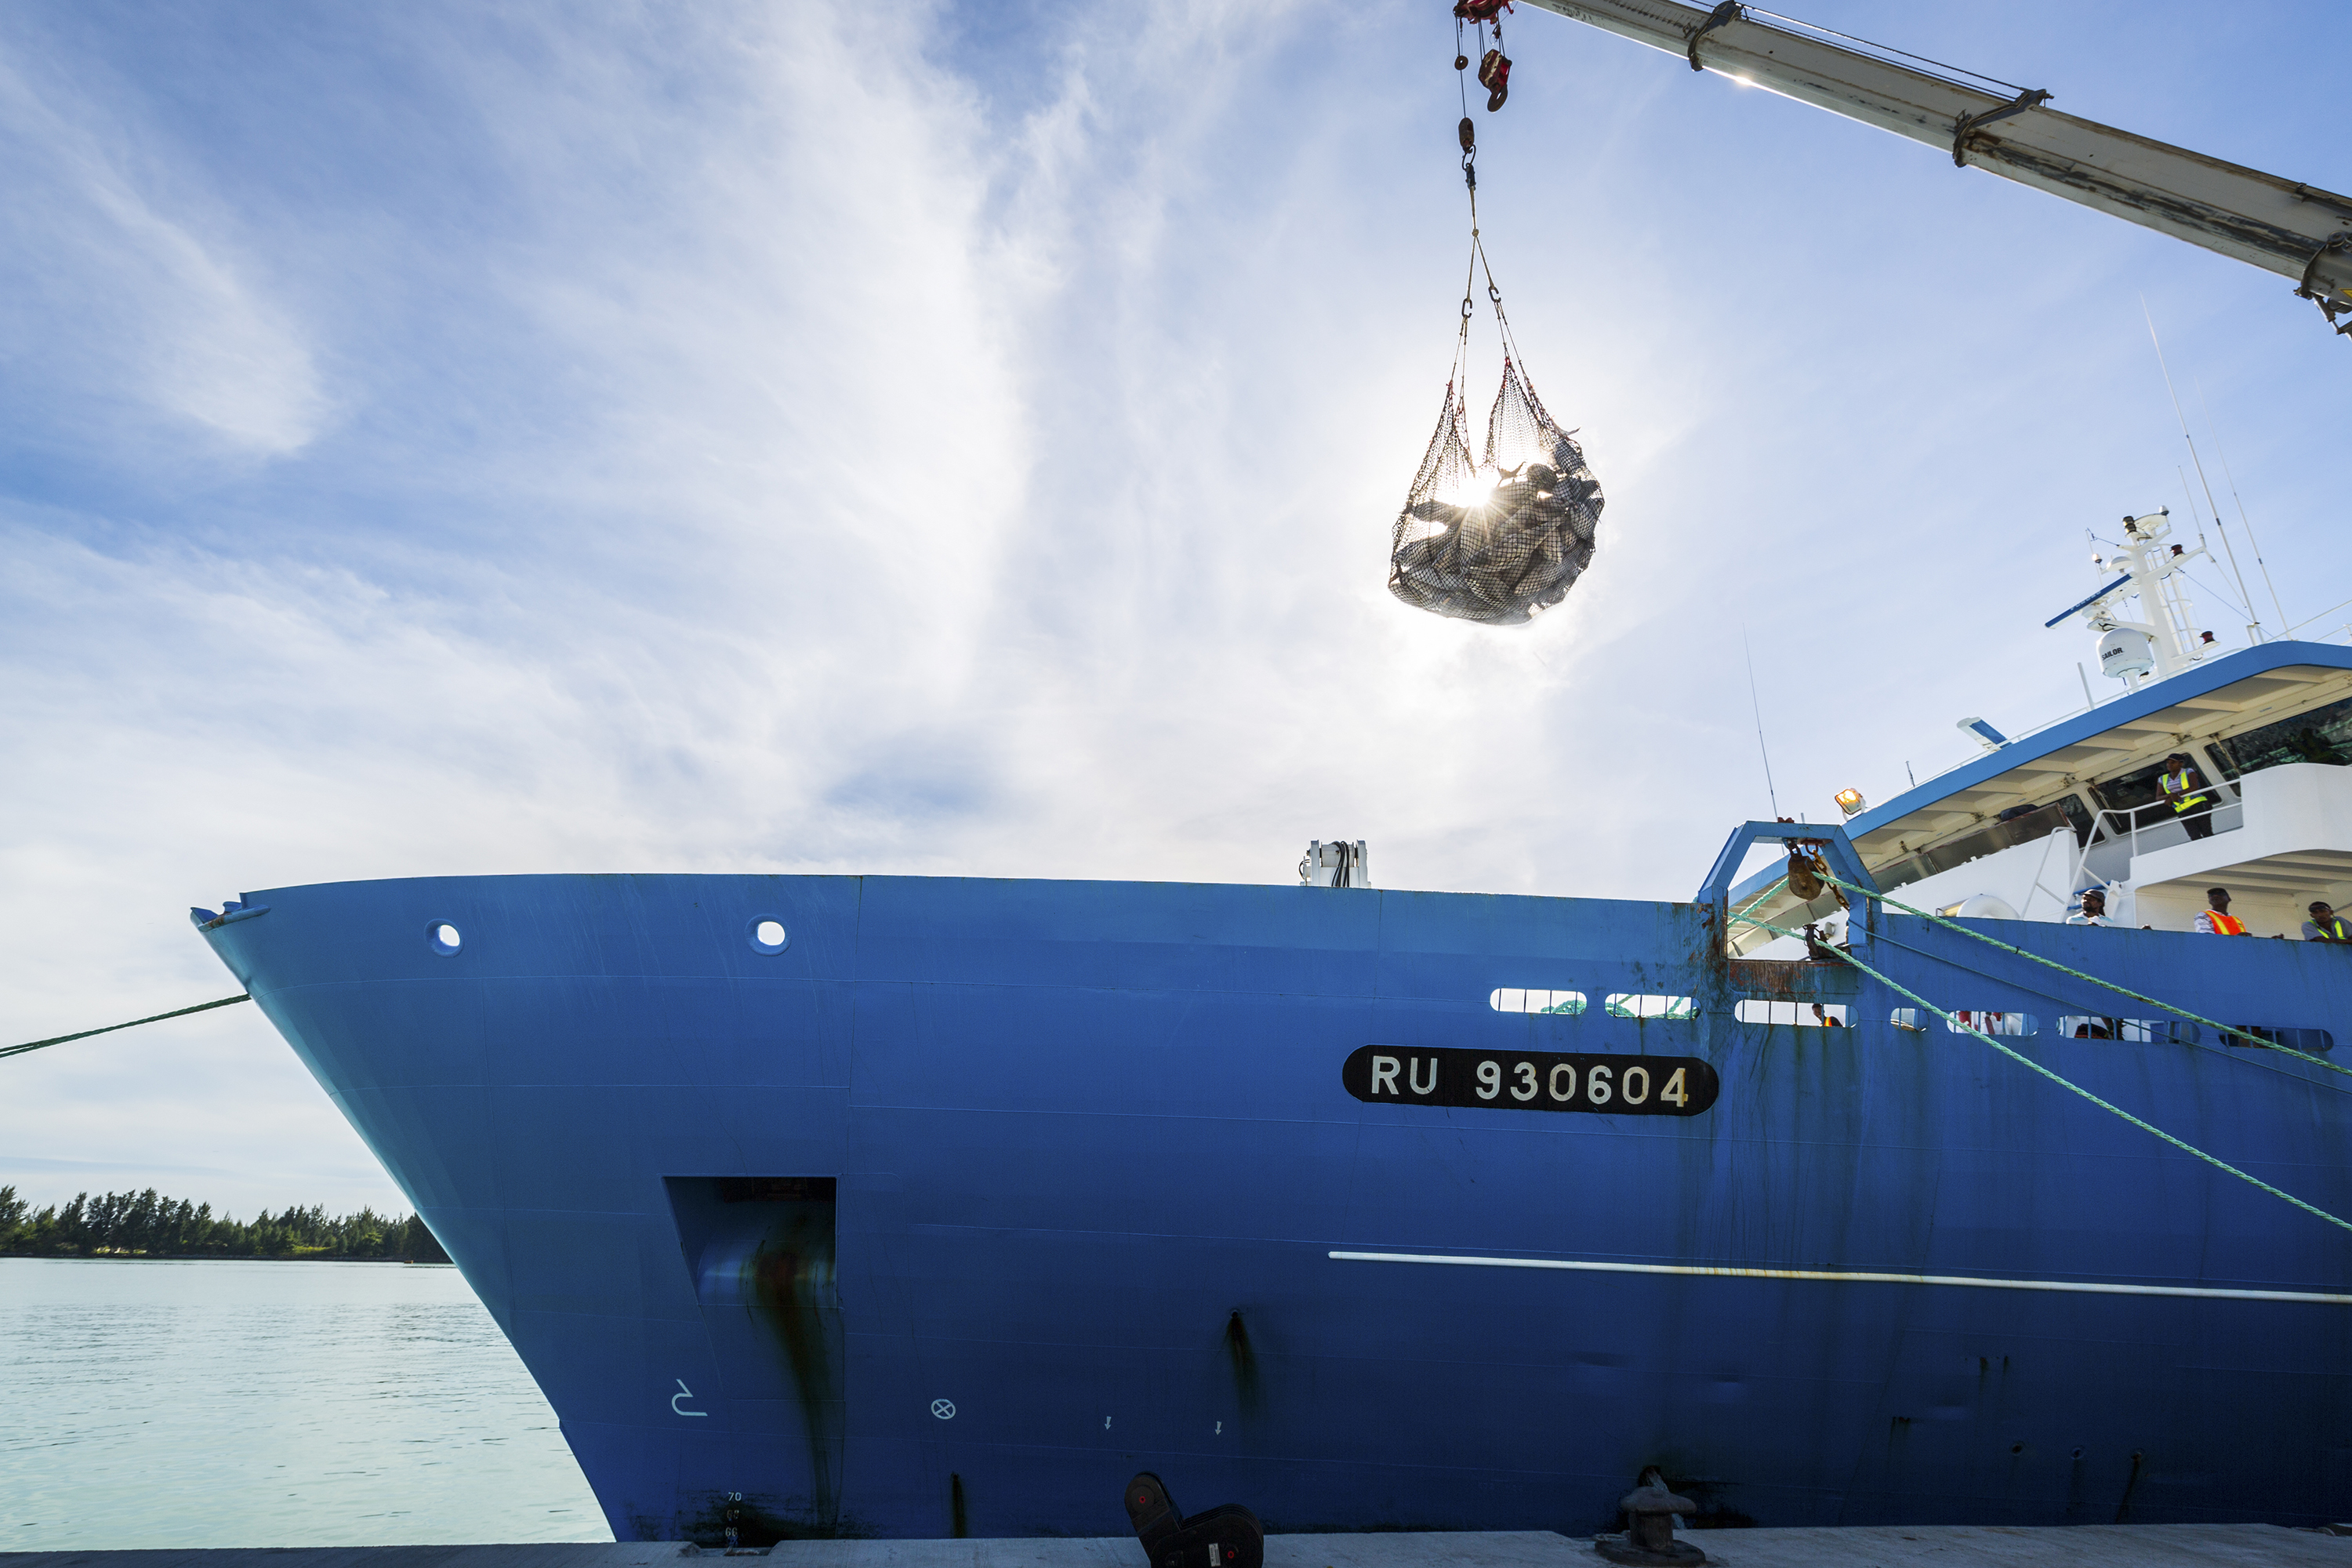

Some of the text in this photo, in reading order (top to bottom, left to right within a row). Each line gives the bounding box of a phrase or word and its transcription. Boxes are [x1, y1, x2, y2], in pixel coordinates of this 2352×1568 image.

[2101, 647, 2123, 661] SAILOR
[1371, 1055, 1689, 1108] RU 930604
[728, 1492, 742, 1501] 70
